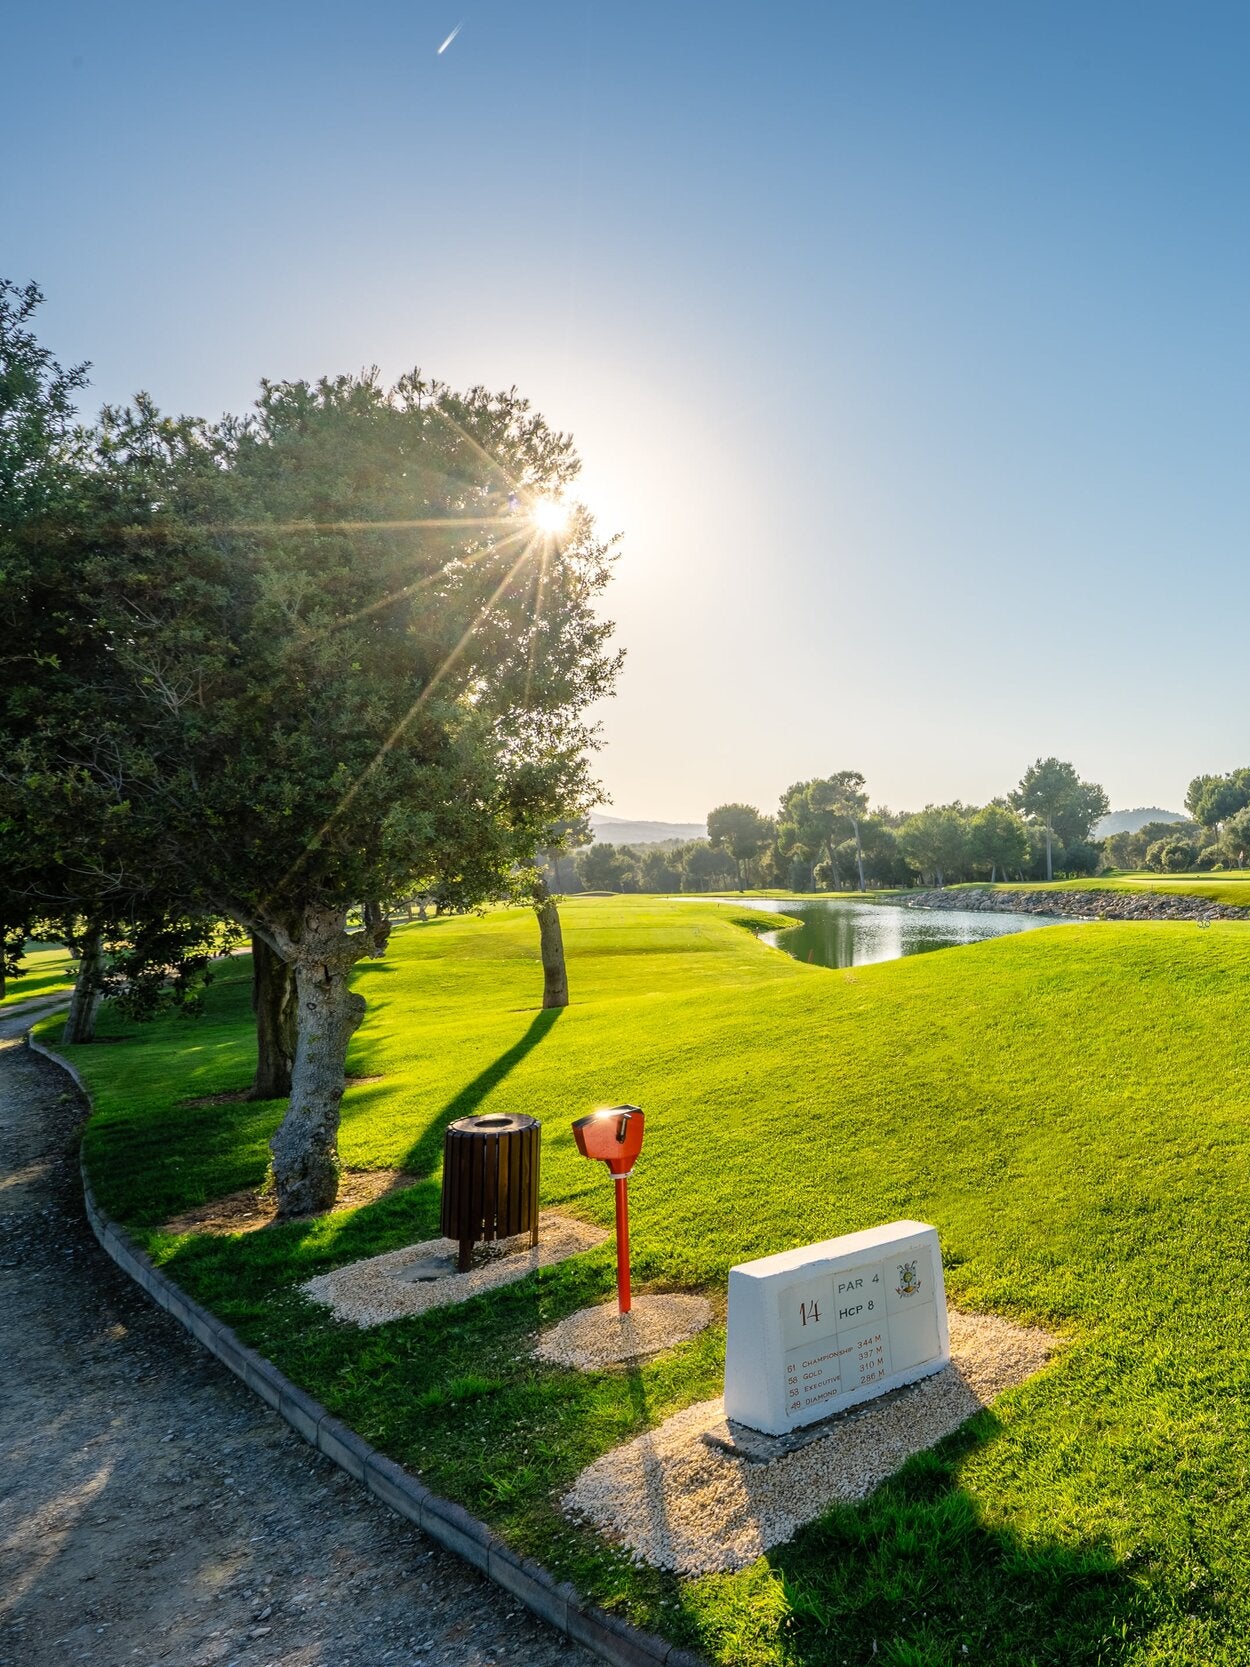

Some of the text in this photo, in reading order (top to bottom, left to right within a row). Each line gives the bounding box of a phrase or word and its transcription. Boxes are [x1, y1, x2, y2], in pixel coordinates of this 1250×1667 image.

[838, 1274, 880, 1294] PAR 4
[799, 1299, 823, 1326] 14
[839, 1300, 874, 1319] HCP 8
[787, 1364, 796, 1373] 61
[857, 1338, 873, 1349] 344
[788, 1376, 798, 1385] 58
[802, 1369, 822, 1380] GOLD
[789, 1388, 799, 1397] 53
[859, 1362, 874, 1372] 310
[877, 1358, 884, 1366] M
[805, 1389, 837, 1406] DIAMOND
[860, 1373, 876, 1384] 286
[878, 1369, 885, 1377] M
